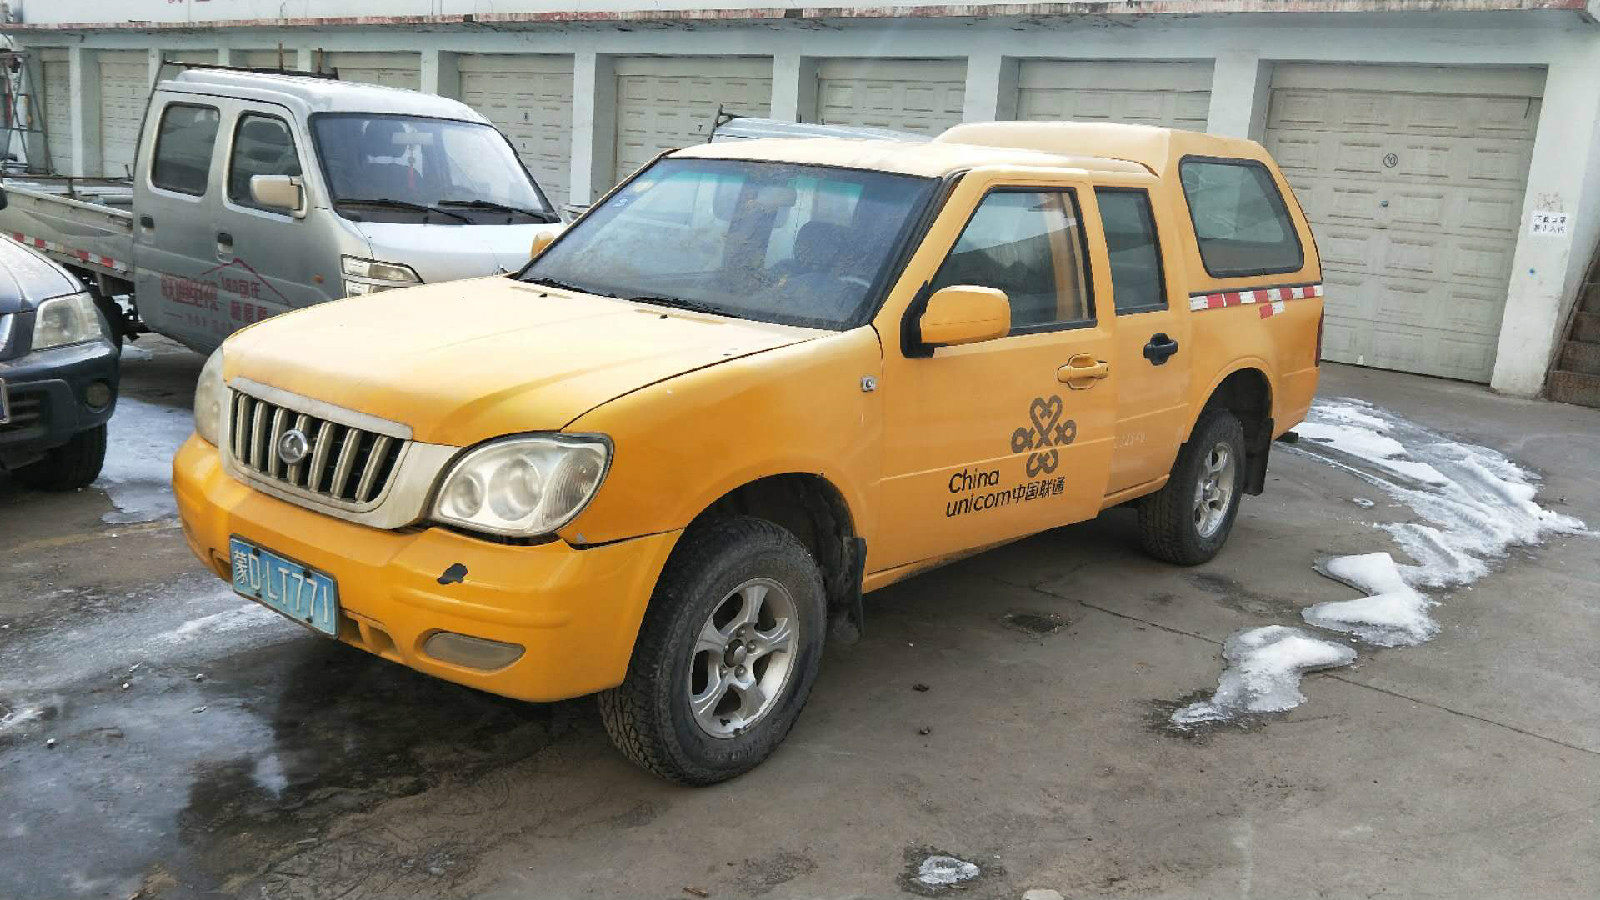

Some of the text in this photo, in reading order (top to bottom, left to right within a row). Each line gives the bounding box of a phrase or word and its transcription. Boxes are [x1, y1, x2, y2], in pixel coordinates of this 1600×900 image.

[946, 475, 1066, 518] unicom 中国联通
[948, 468, 1000, 494] China
